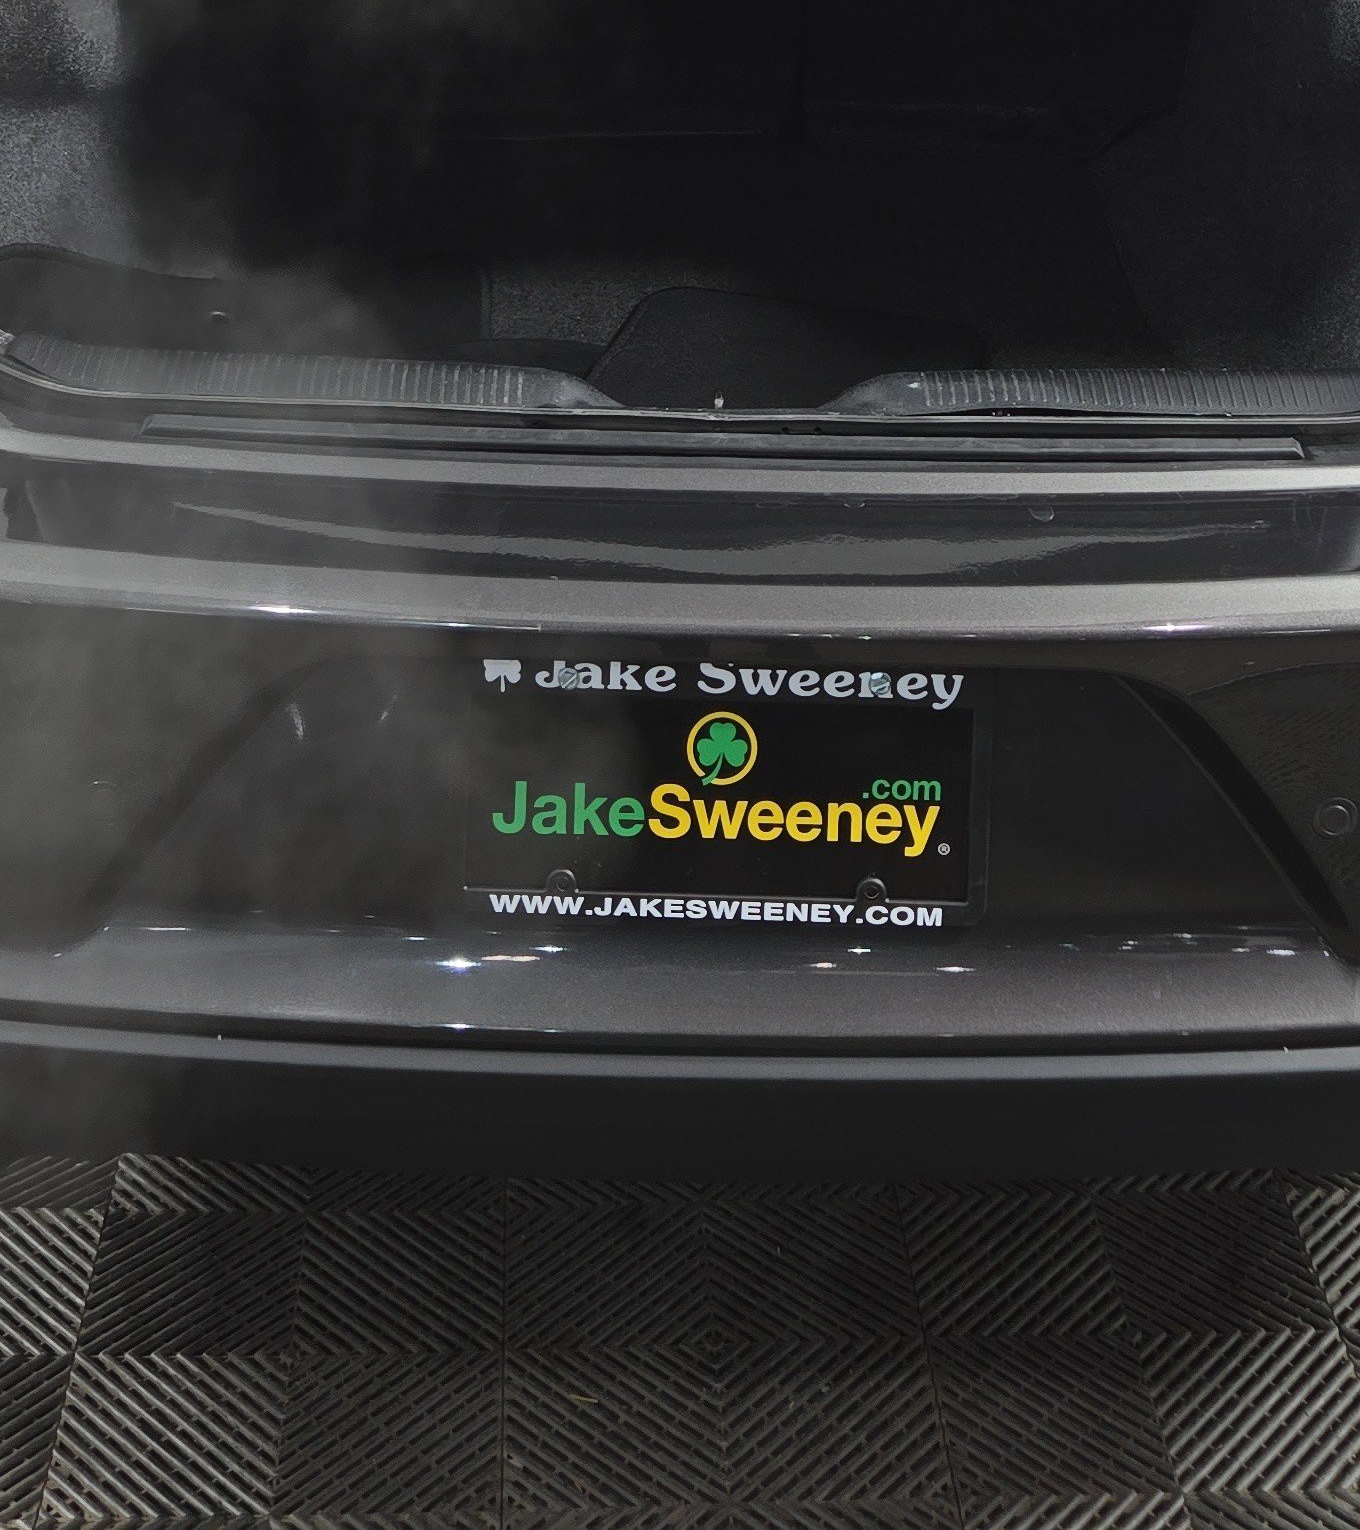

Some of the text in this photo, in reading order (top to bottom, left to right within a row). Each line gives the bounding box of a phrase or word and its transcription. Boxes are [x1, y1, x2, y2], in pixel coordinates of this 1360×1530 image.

[535, 659, 965, 711] Jake Sweeney
[488, 893, 944, 927] WWW.JAKESWEENEY.COM
